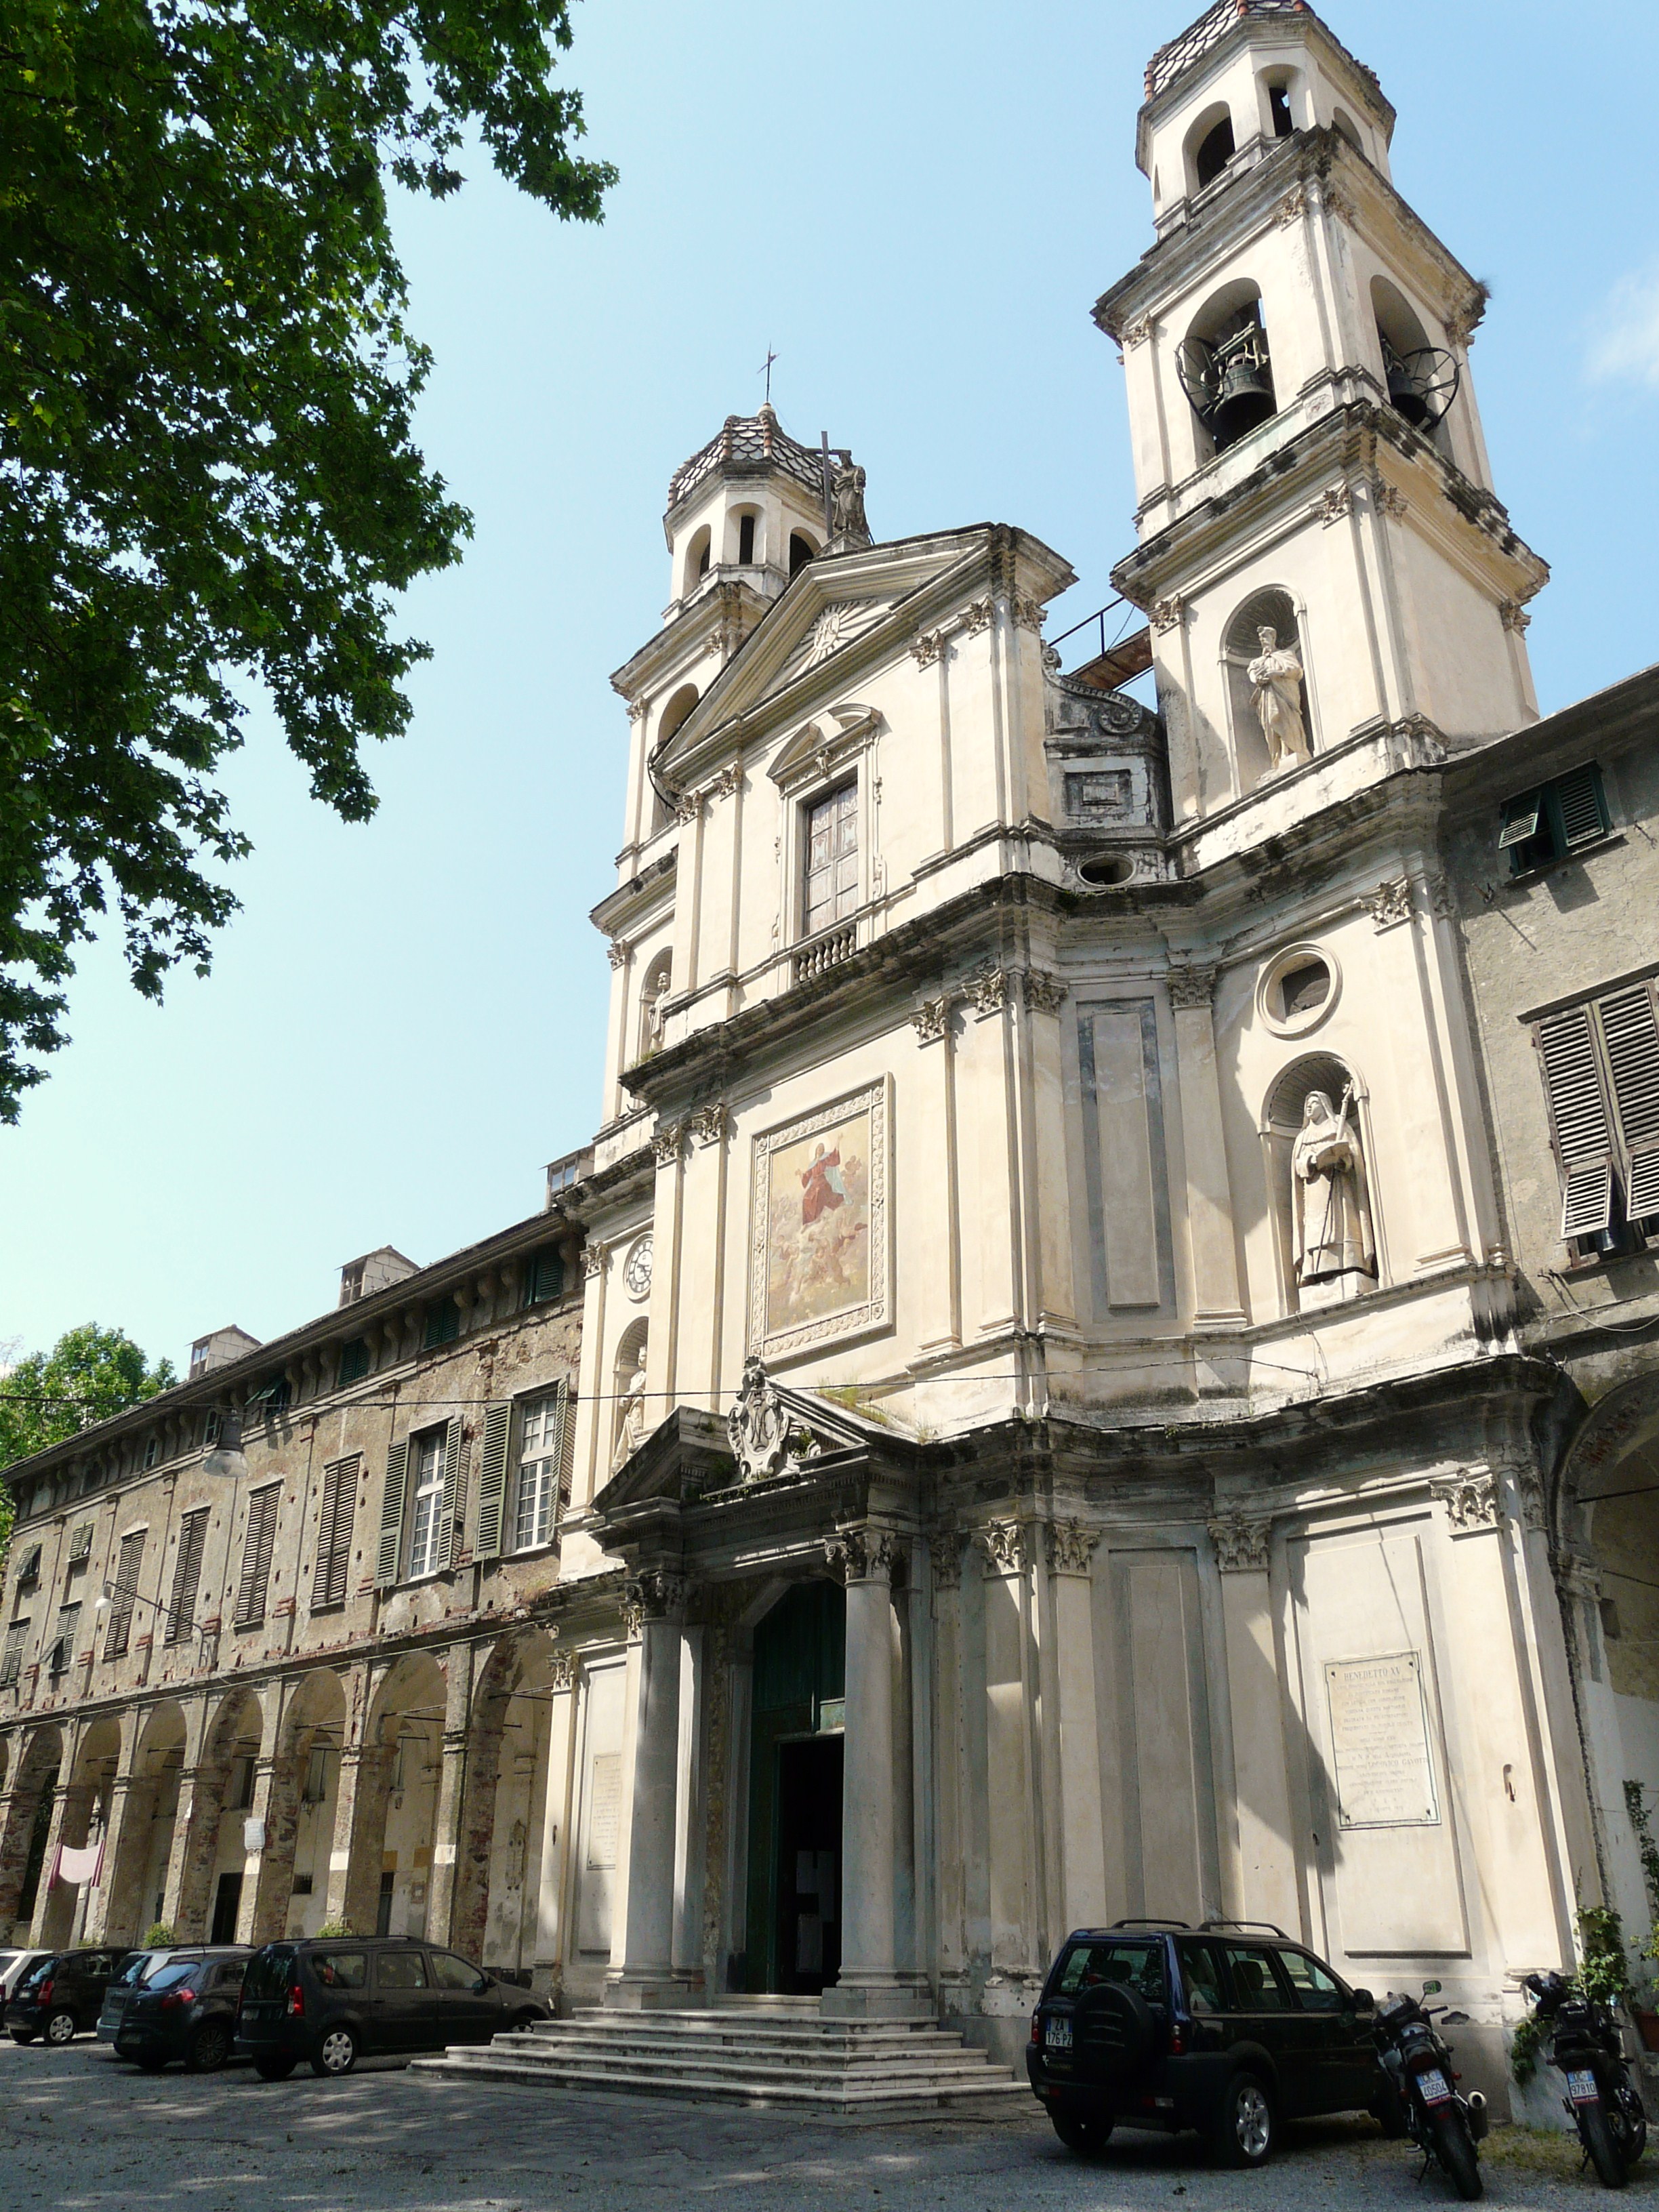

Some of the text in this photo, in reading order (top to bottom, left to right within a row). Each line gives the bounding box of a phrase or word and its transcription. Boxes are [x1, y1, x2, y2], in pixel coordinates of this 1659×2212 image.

[1344, 1666, 1401, 1681] BENEDETTO XV
[1055, 2019, 1064, 2030] ZA
[1048, 2032, 1071, 2046] 176 PZ
[1424, 2081, 1446, 2097] 40504
[1572, 2083, 1595, 2095] 97810
